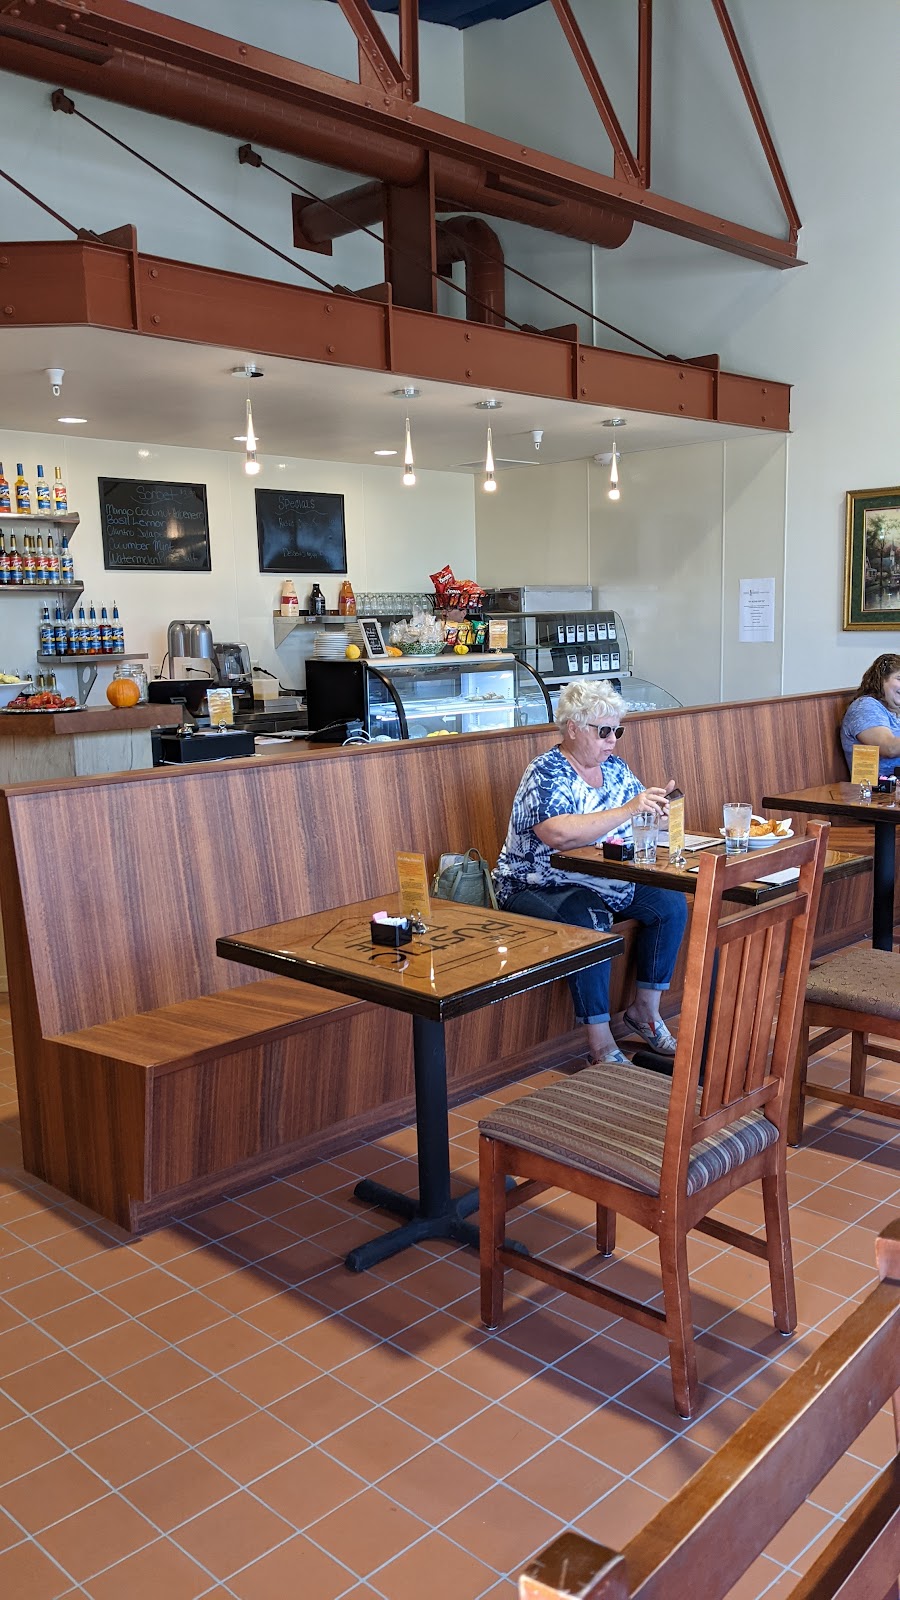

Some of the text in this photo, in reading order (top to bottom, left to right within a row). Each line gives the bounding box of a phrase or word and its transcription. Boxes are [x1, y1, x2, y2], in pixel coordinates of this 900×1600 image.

[136, 485, 178, 500] Sorbet
[278, 495, 316, 510] Specials
[105, 503, 134, 519] Mango
[106, 514, 130, 526] Basil
[108, 537, 150, 551] Cucumber
[368, 919, 514, 965] RUSTIC
